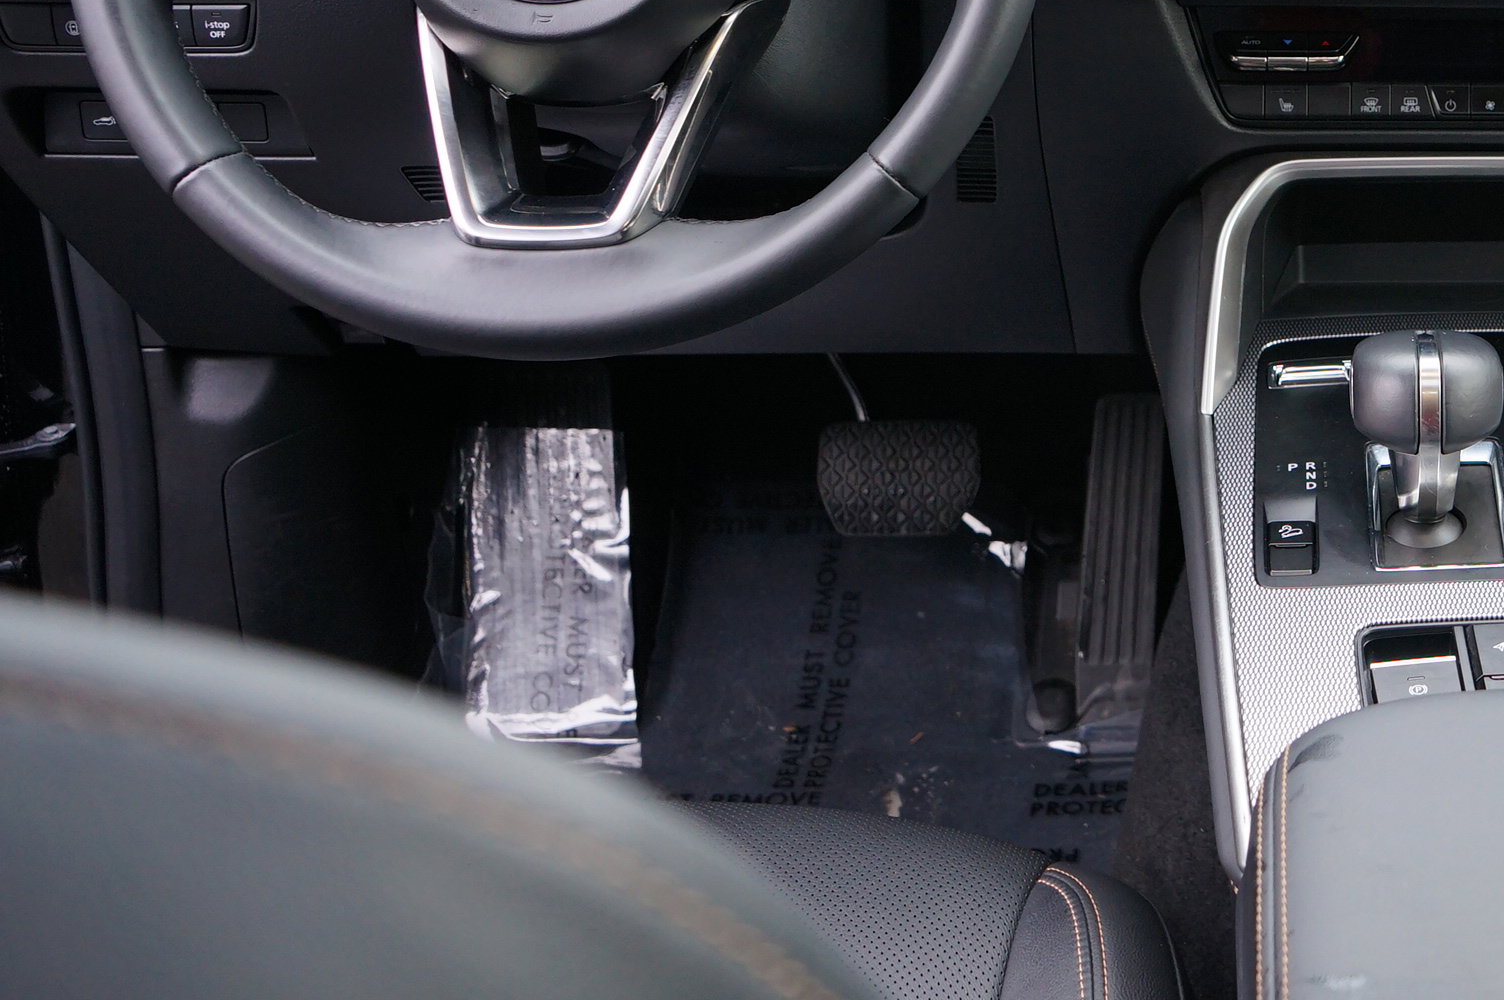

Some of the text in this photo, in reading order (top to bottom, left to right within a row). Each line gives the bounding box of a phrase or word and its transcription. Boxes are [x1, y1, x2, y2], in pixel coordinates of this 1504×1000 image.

[204, 20, 230, 31] i-stop
[209, 30, 226, 39] OFF
[1360, 105, 1382, 113] FRONT
[1400, 105, 1421, 113] REAR
[1287, 461, 1317, 472] P R
[1305, 471, 1317, 480] N
[1305, 481, 1317, 490] D
[803, 590, 863, 789] PROTECTIVE COVER
[772, 723, 812, 789] DEALER
[796, 649, 825, 710] MUST
[1033, 780, 1129, 798] DEALER
